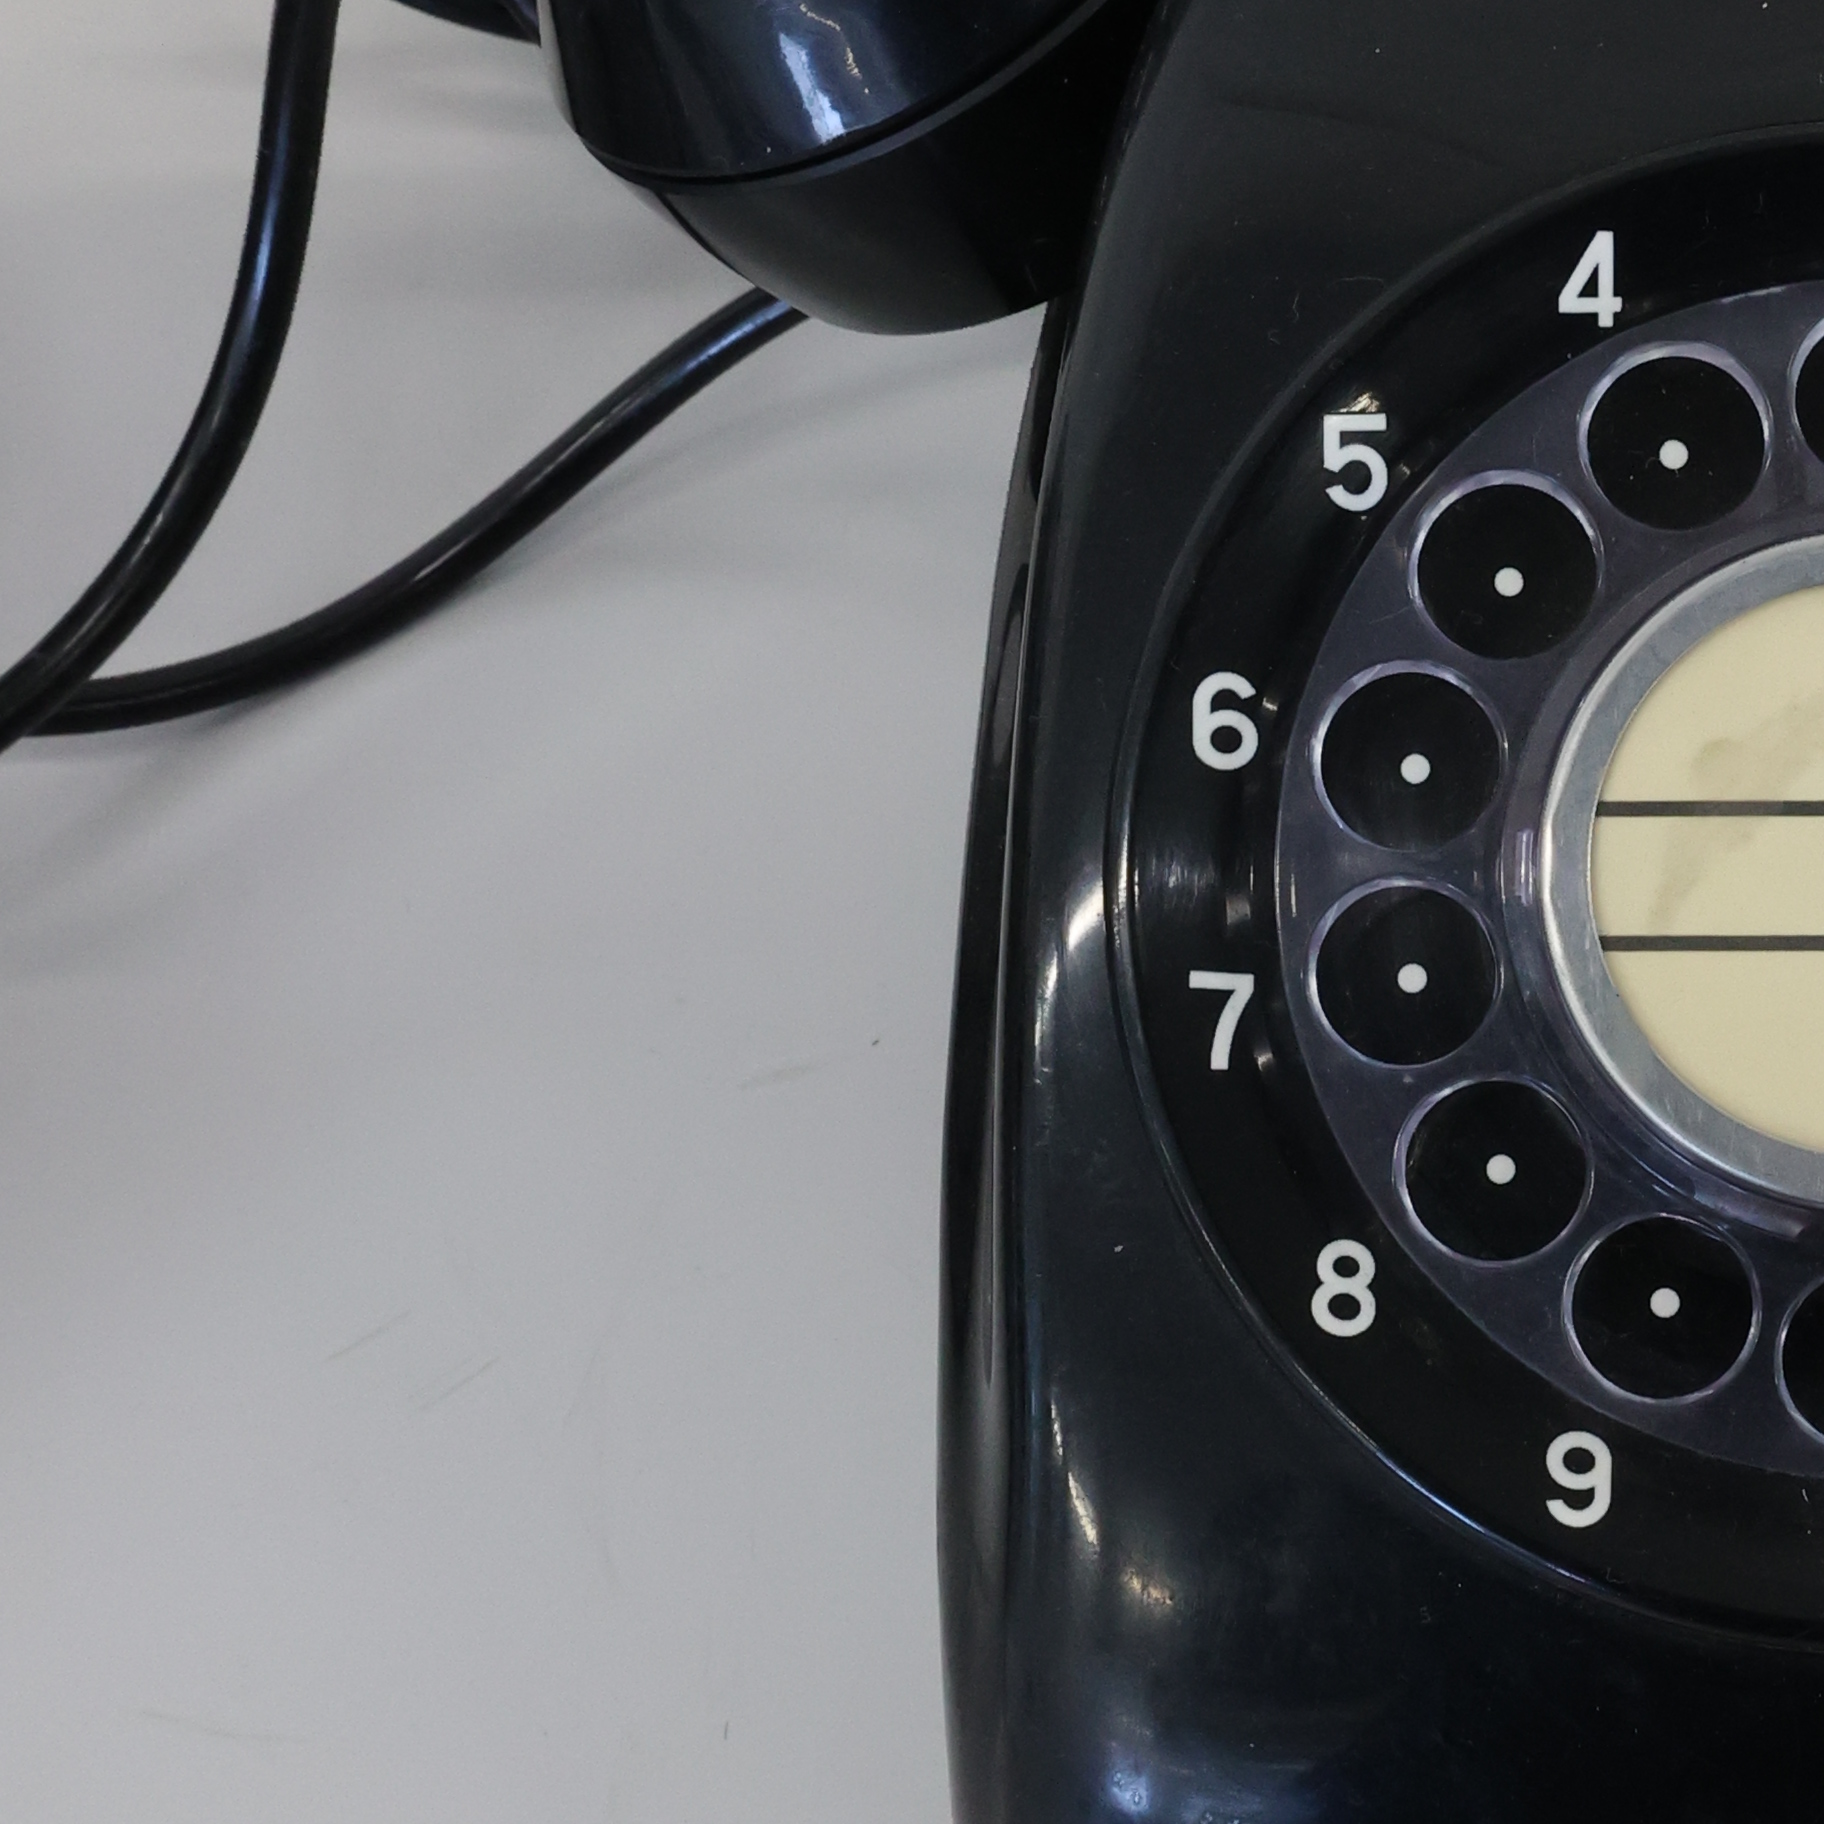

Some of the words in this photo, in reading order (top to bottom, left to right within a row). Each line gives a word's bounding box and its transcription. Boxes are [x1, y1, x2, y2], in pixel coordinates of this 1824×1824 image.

[1559, 231, 1622, 327] 4
[1324, 413, 1388, 511] 5
[1193, 673, 1257, 769] 6
[1190, 971, 1254, 1069] 7
[1312, 1240, 1376, 1337] 8
[1547, 1432, 1612, 1527] 9
